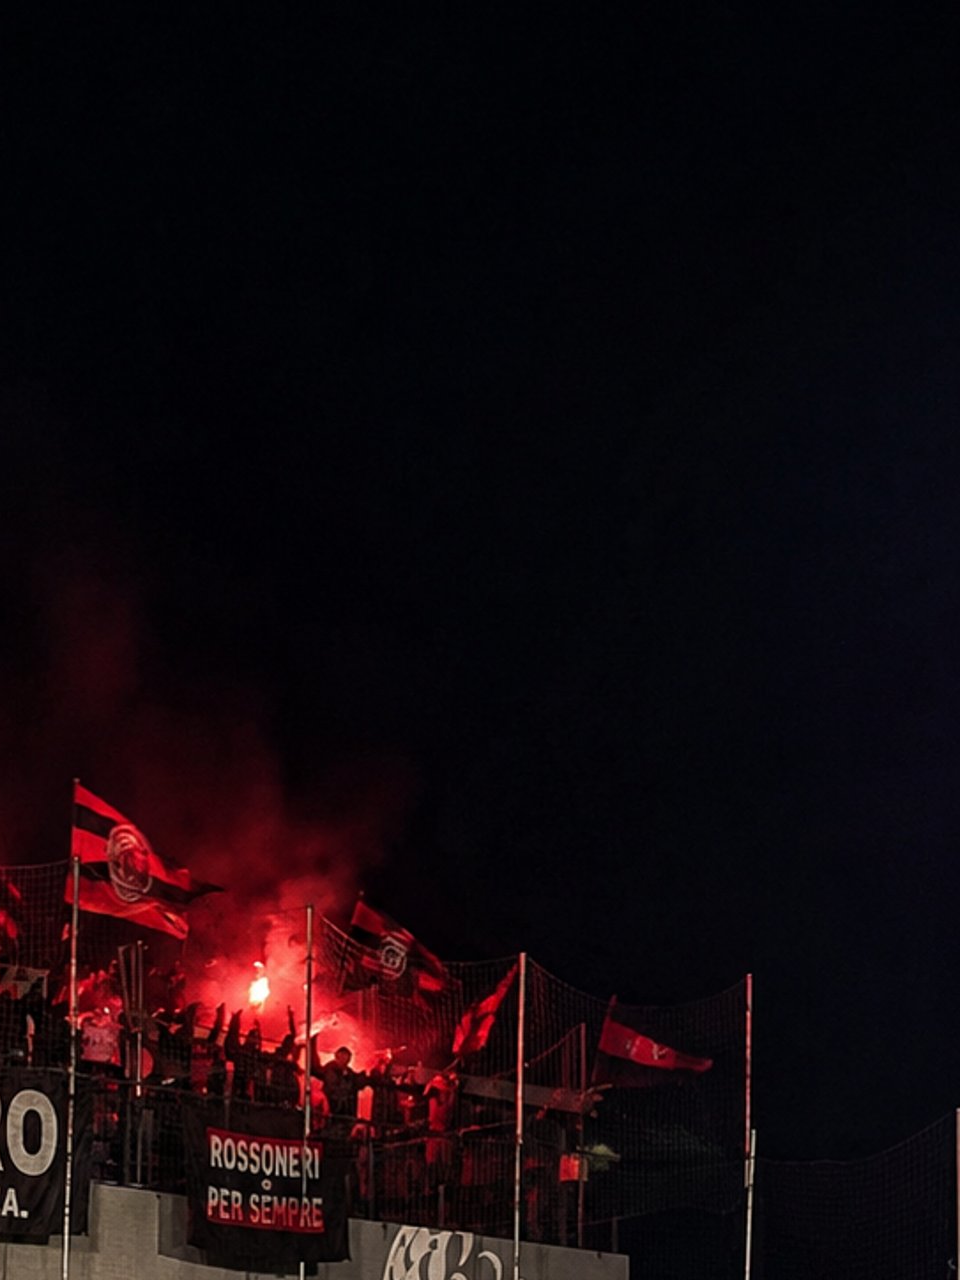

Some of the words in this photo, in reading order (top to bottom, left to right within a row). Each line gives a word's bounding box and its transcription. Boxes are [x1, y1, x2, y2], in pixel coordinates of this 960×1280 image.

[210, 1134, 320, 1179] ROSSONERI
[207, 1185, 244, 1221] PER
[249, 1193, 323, 1228] SEMPRE
